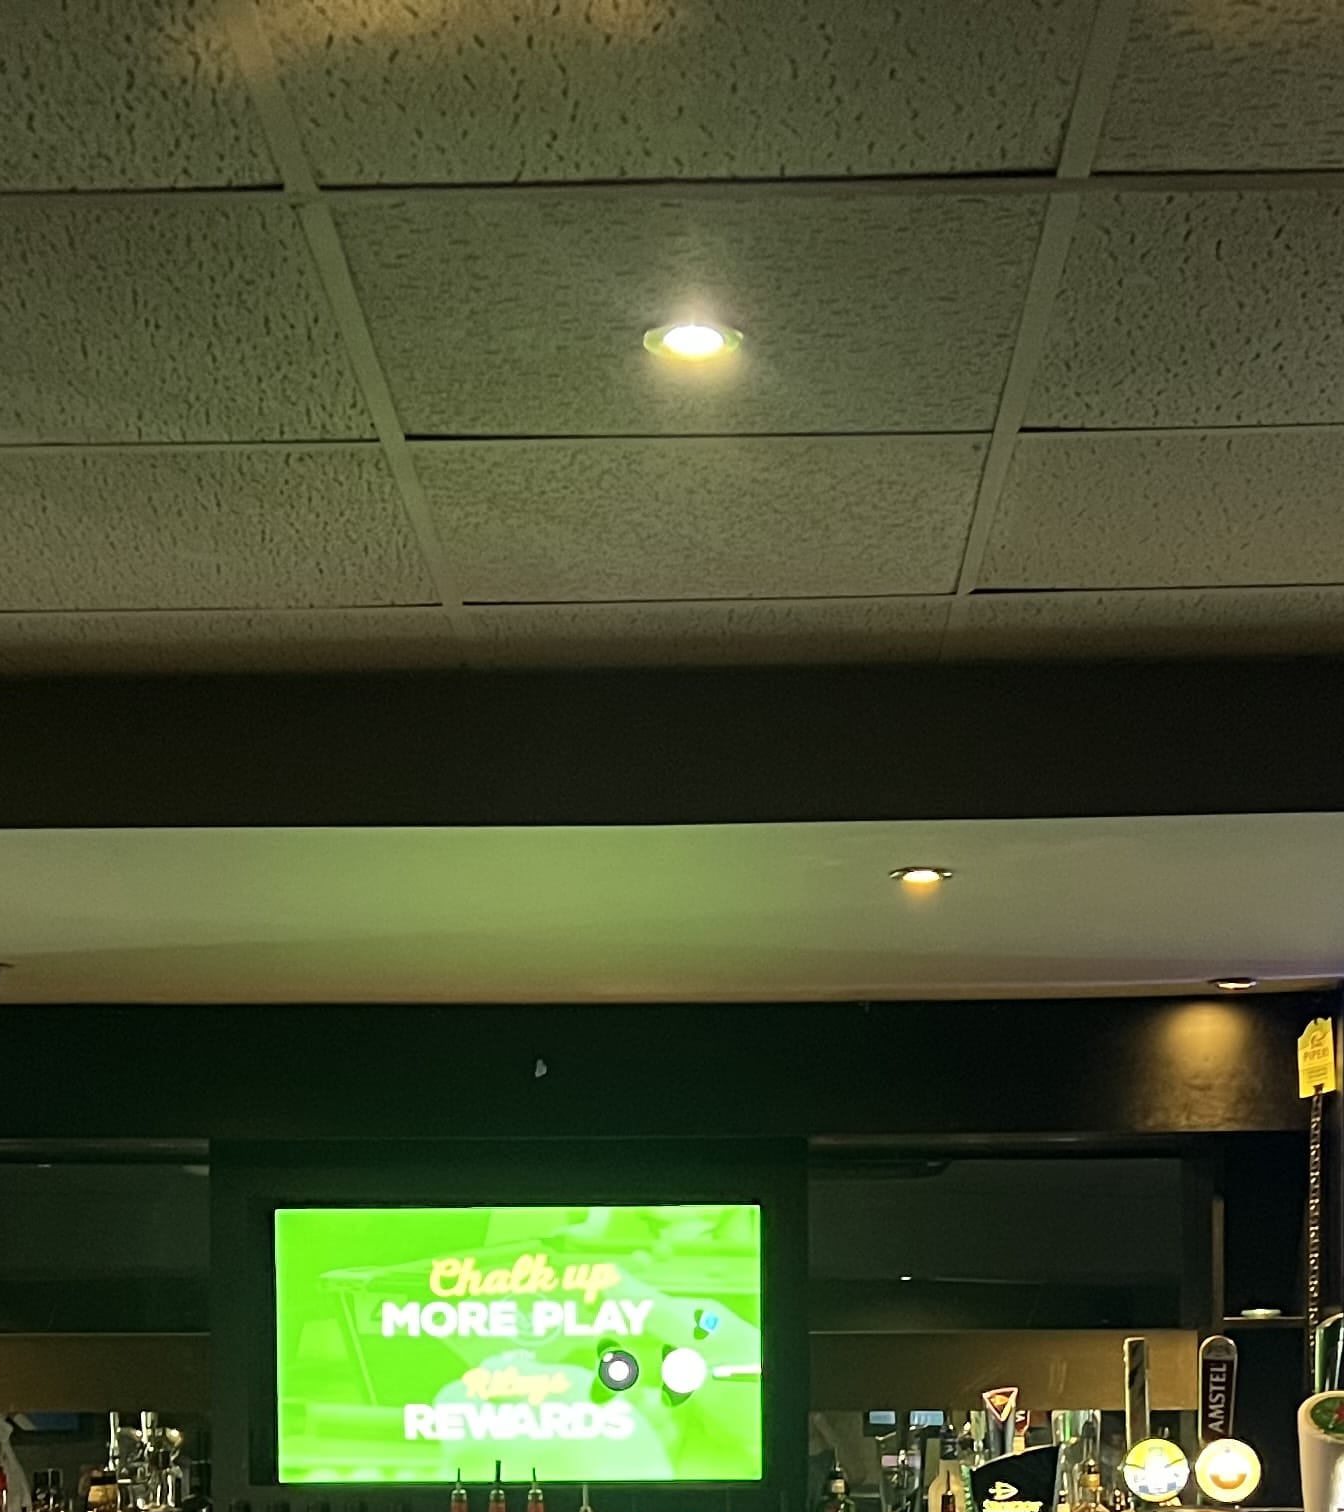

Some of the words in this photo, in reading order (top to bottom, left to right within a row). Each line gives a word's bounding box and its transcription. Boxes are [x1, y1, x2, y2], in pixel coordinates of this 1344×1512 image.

[429, 1254, 554, 1297] Chalk
[563, 1262, 621, 1304] up
[381, 1301, 518, 1337] MORE
[533, 1300, 654, 1337] PLAY
[1208, 1362, 1227, 1433] AMSTEL
[404, 1402, 635, 1440] REWARDS
